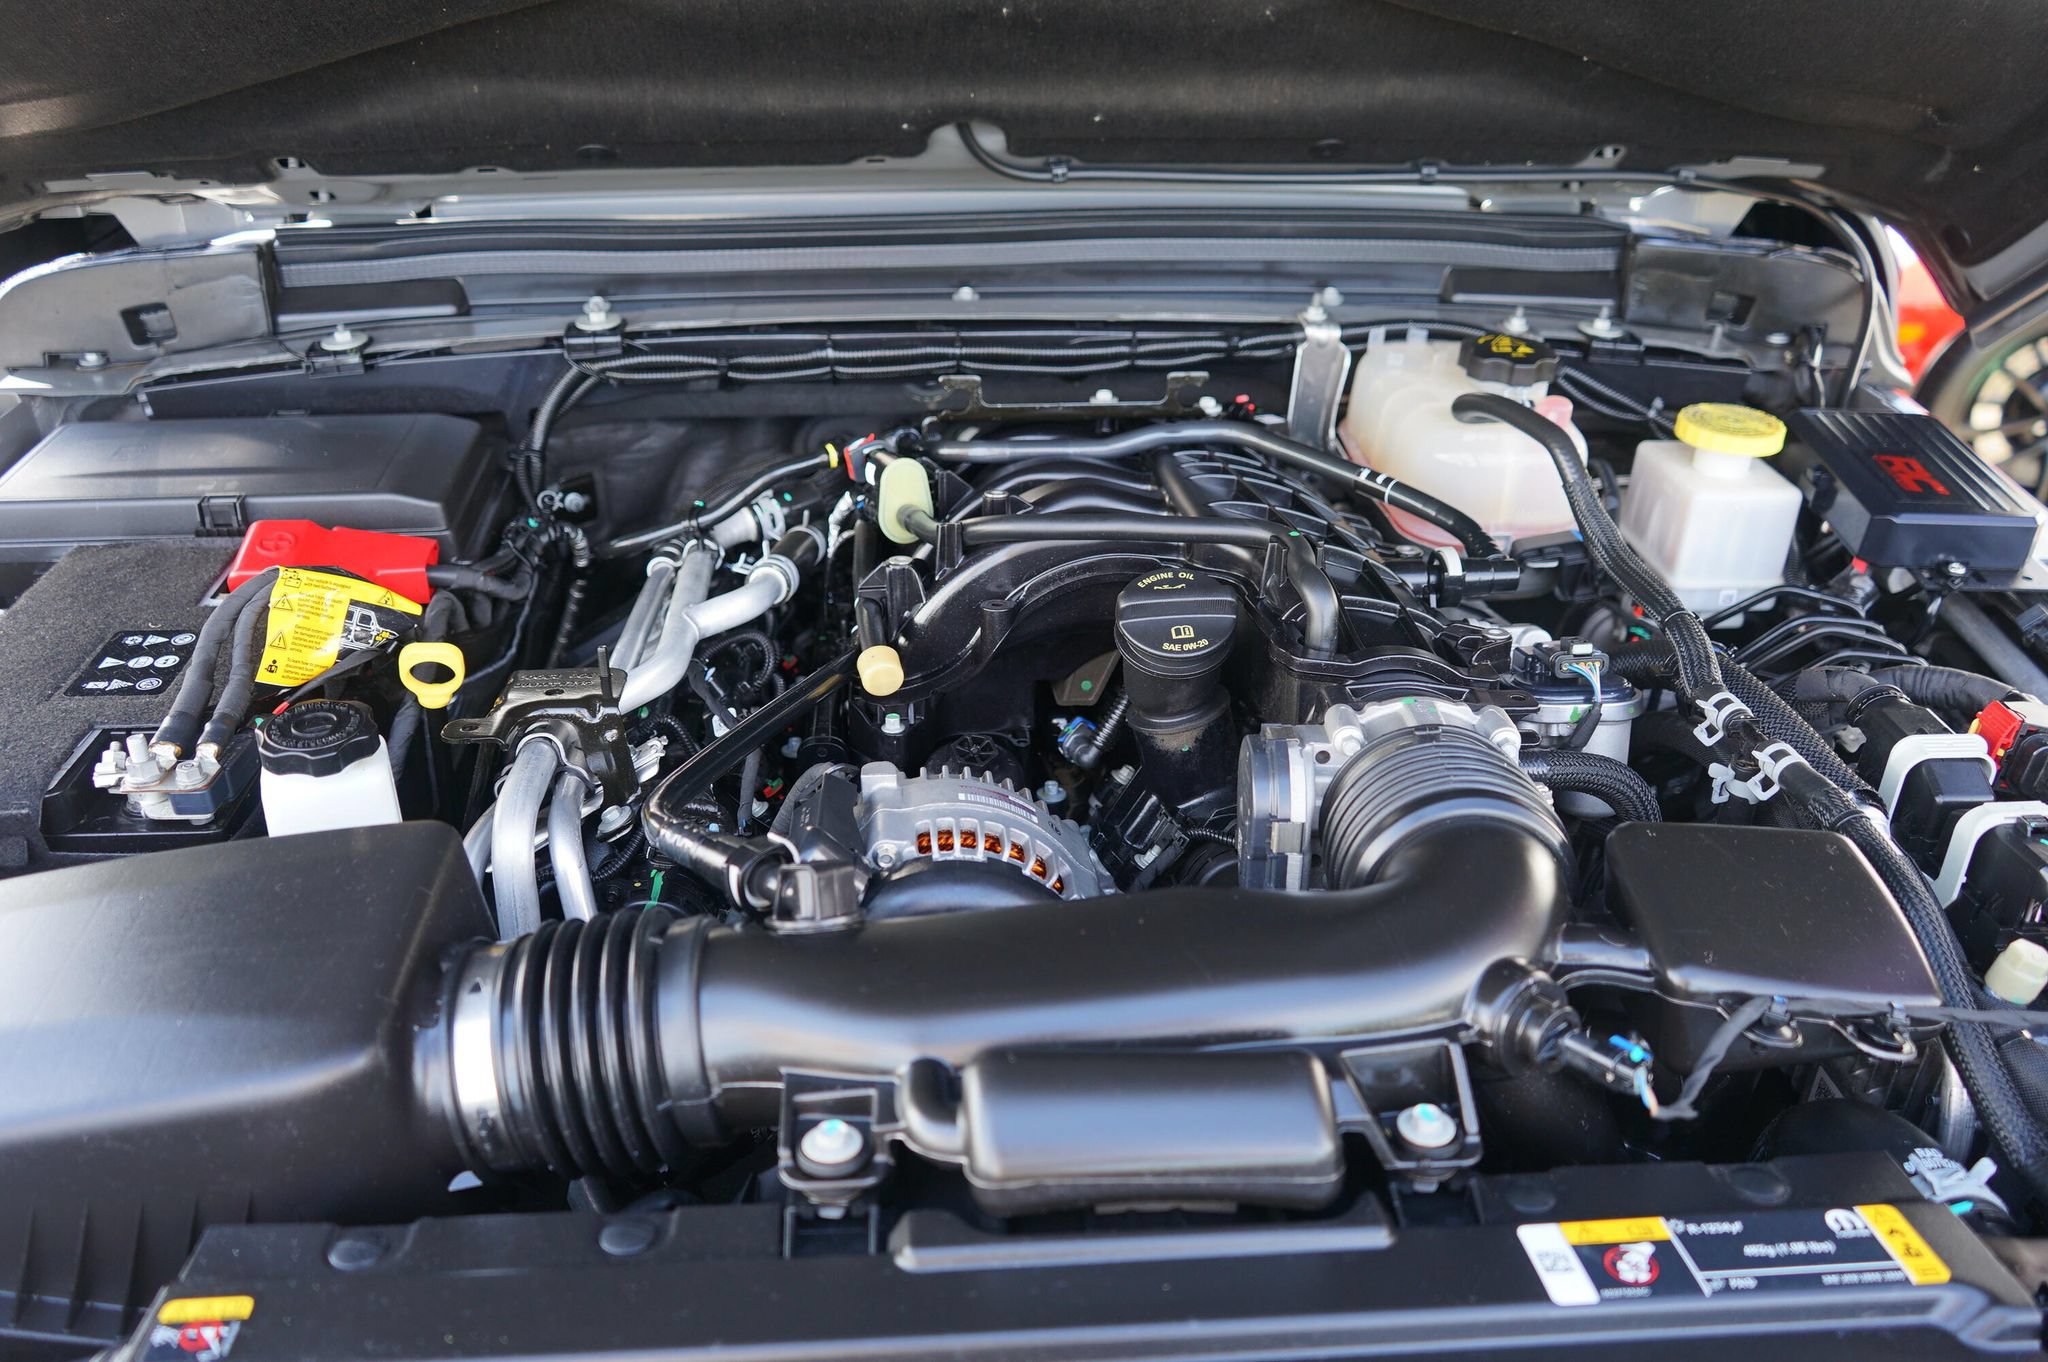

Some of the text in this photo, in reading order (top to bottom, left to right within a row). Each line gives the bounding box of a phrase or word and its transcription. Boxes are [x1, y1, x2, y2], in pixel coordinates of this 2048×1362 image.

[1137, 571, 1195, 588] ENGINE OIL
[1162, 638, 1209, 651] SAE 0W-20
